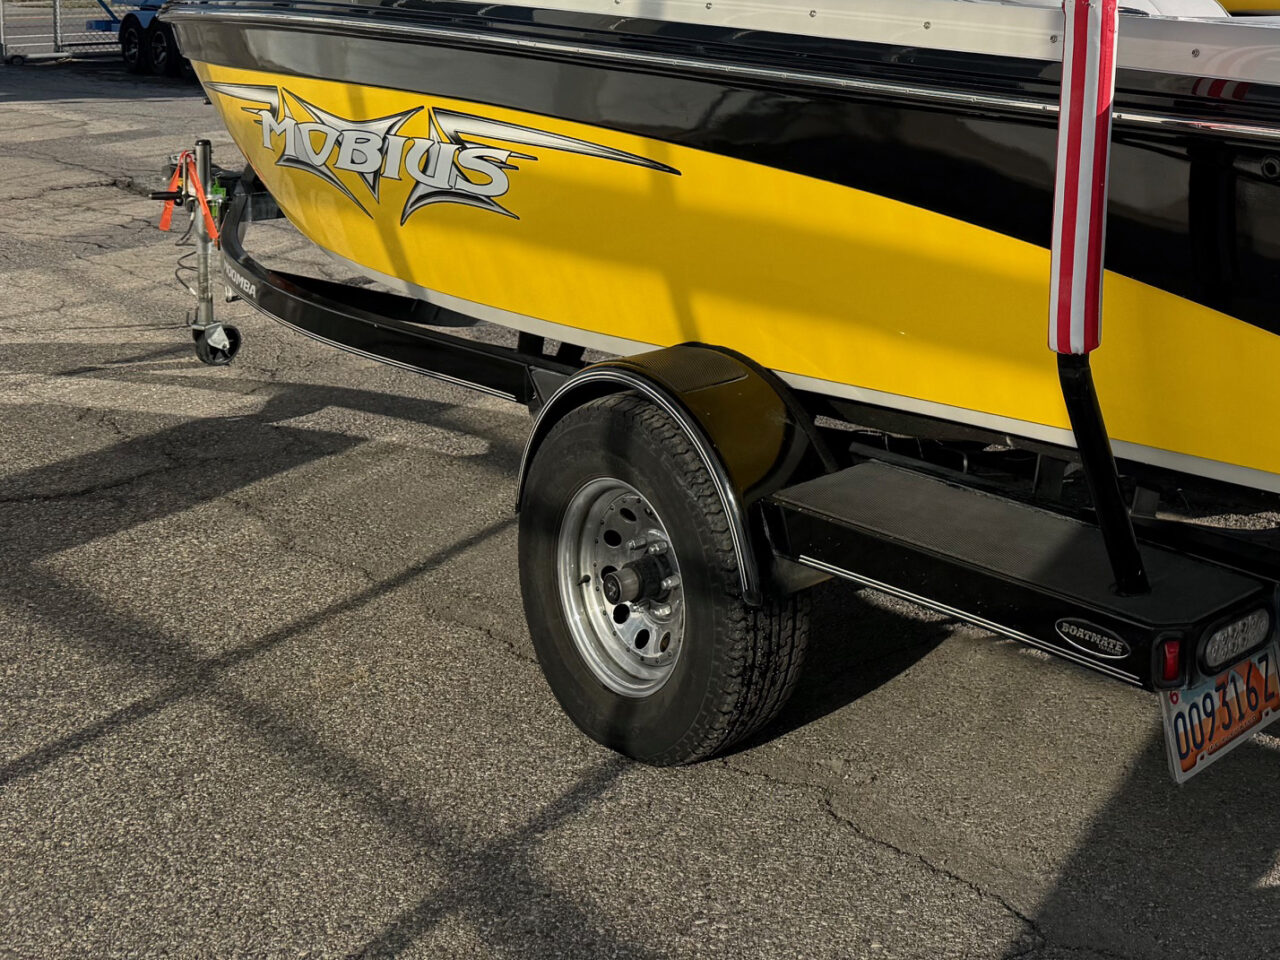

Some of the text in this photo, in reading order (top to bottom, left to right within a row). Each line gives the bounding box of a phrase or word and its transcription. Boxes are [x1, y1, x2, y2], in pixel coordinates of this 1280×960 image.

[258, 110, 512, 198] MOBIUS
[1061, 622, 1124, 652] BOATMATE
[1174, 653, 1275, 760] 009316Z
